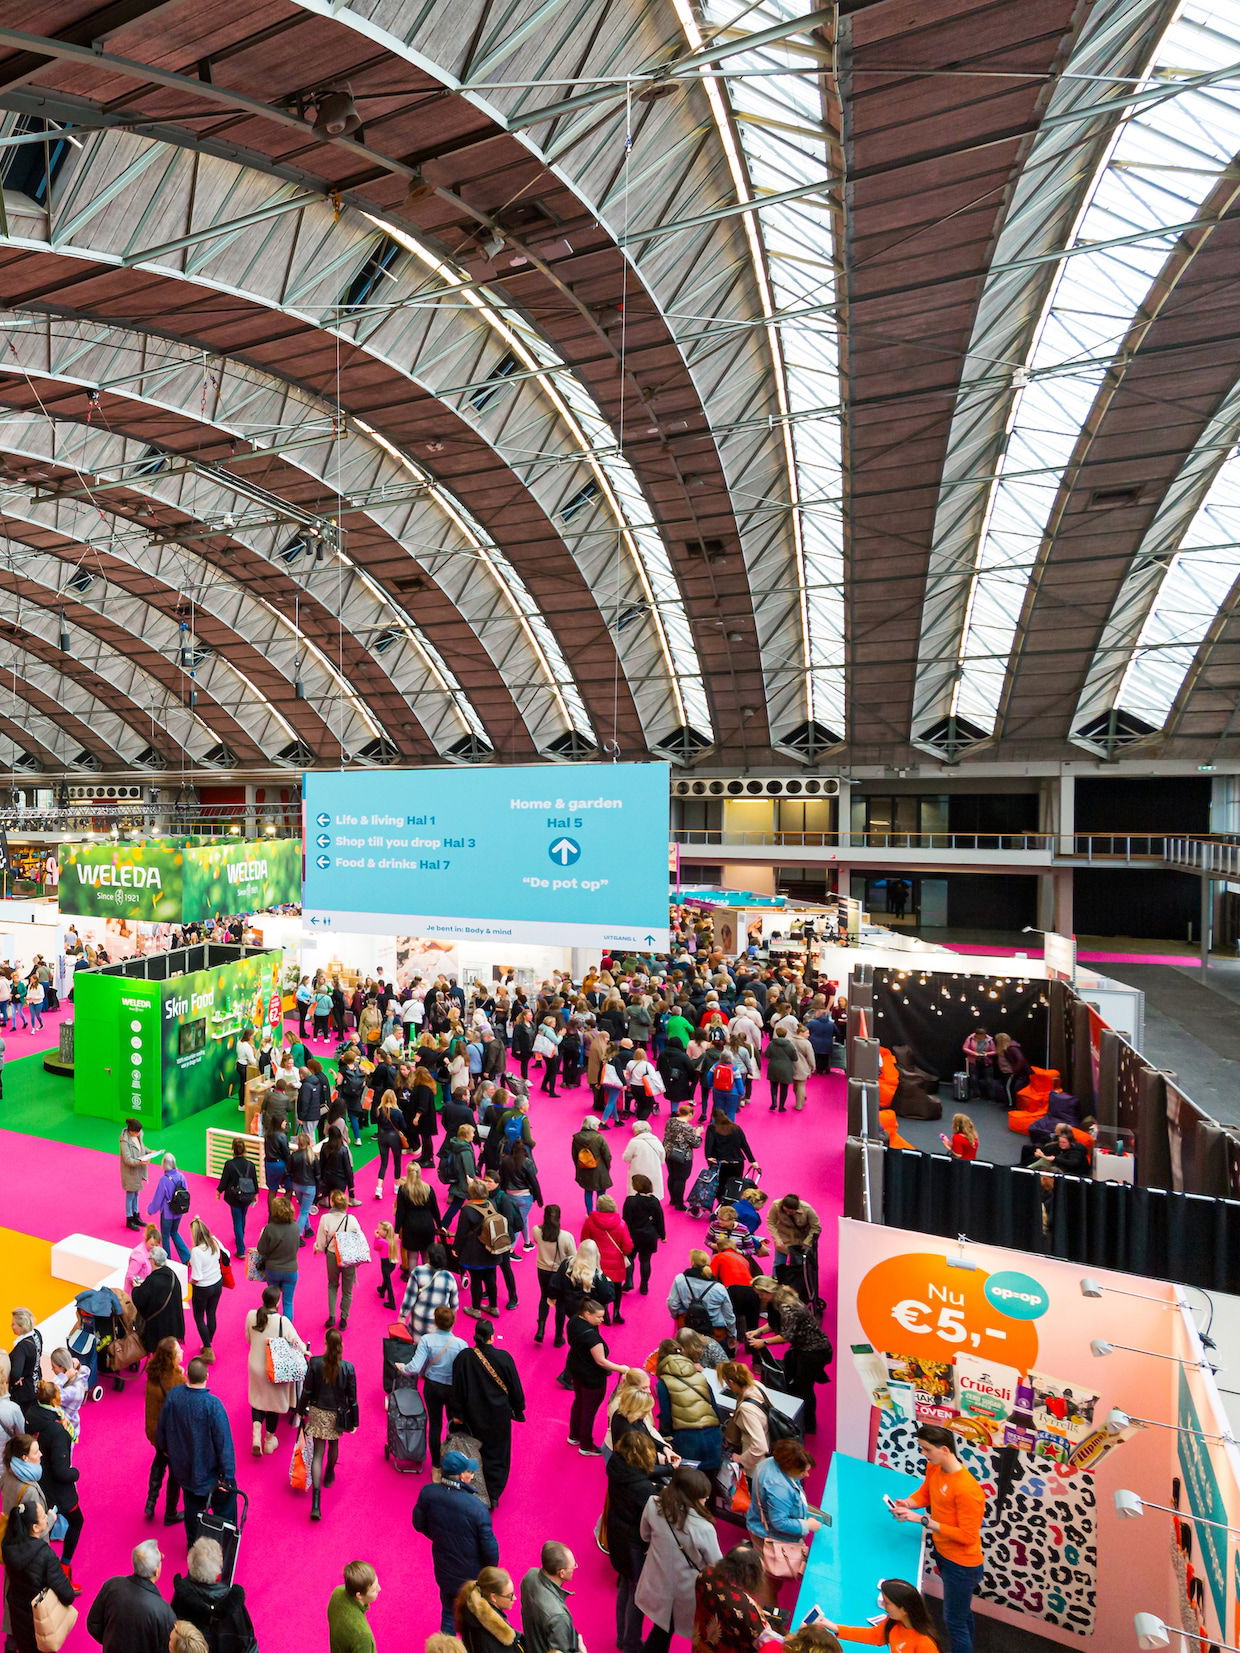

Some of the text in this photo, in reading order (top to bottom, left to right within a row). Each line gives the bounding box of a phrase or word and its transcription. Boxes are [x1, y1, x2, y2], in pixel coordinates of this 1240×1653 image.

[510, 797, 623, 812] Home & garden
[336, 814, 436, 828] Life & living Hal 1
[547, 817, 583, 828] Hal 5
[336, 836, 476, 850] Shop till you drop Hal 3
[336, 857, 451, 870] Food & drinks Hal 7
[76, 863, 162, 888] WELEDA
[227, 859, 268, 884] WELEDA
[552, 878, 577, 890] pot
[96, 891, 139, 902] Since 1921
[465, 927, 484, 935] Body
[492, 928, 512, 936] mind
[121, 997, 151, 1009] WELEDA
[165, 987, 215, 1019] Skin Food
[928, 1282, 965, 1307] Nu
[991, 1286, 1042, 1306] op=op
[891, 1299, 1007, 1348] €5,-
[960, 1376, 1011, 1401] Cruesli
[920, 1406, 953, 1420] OVEN
